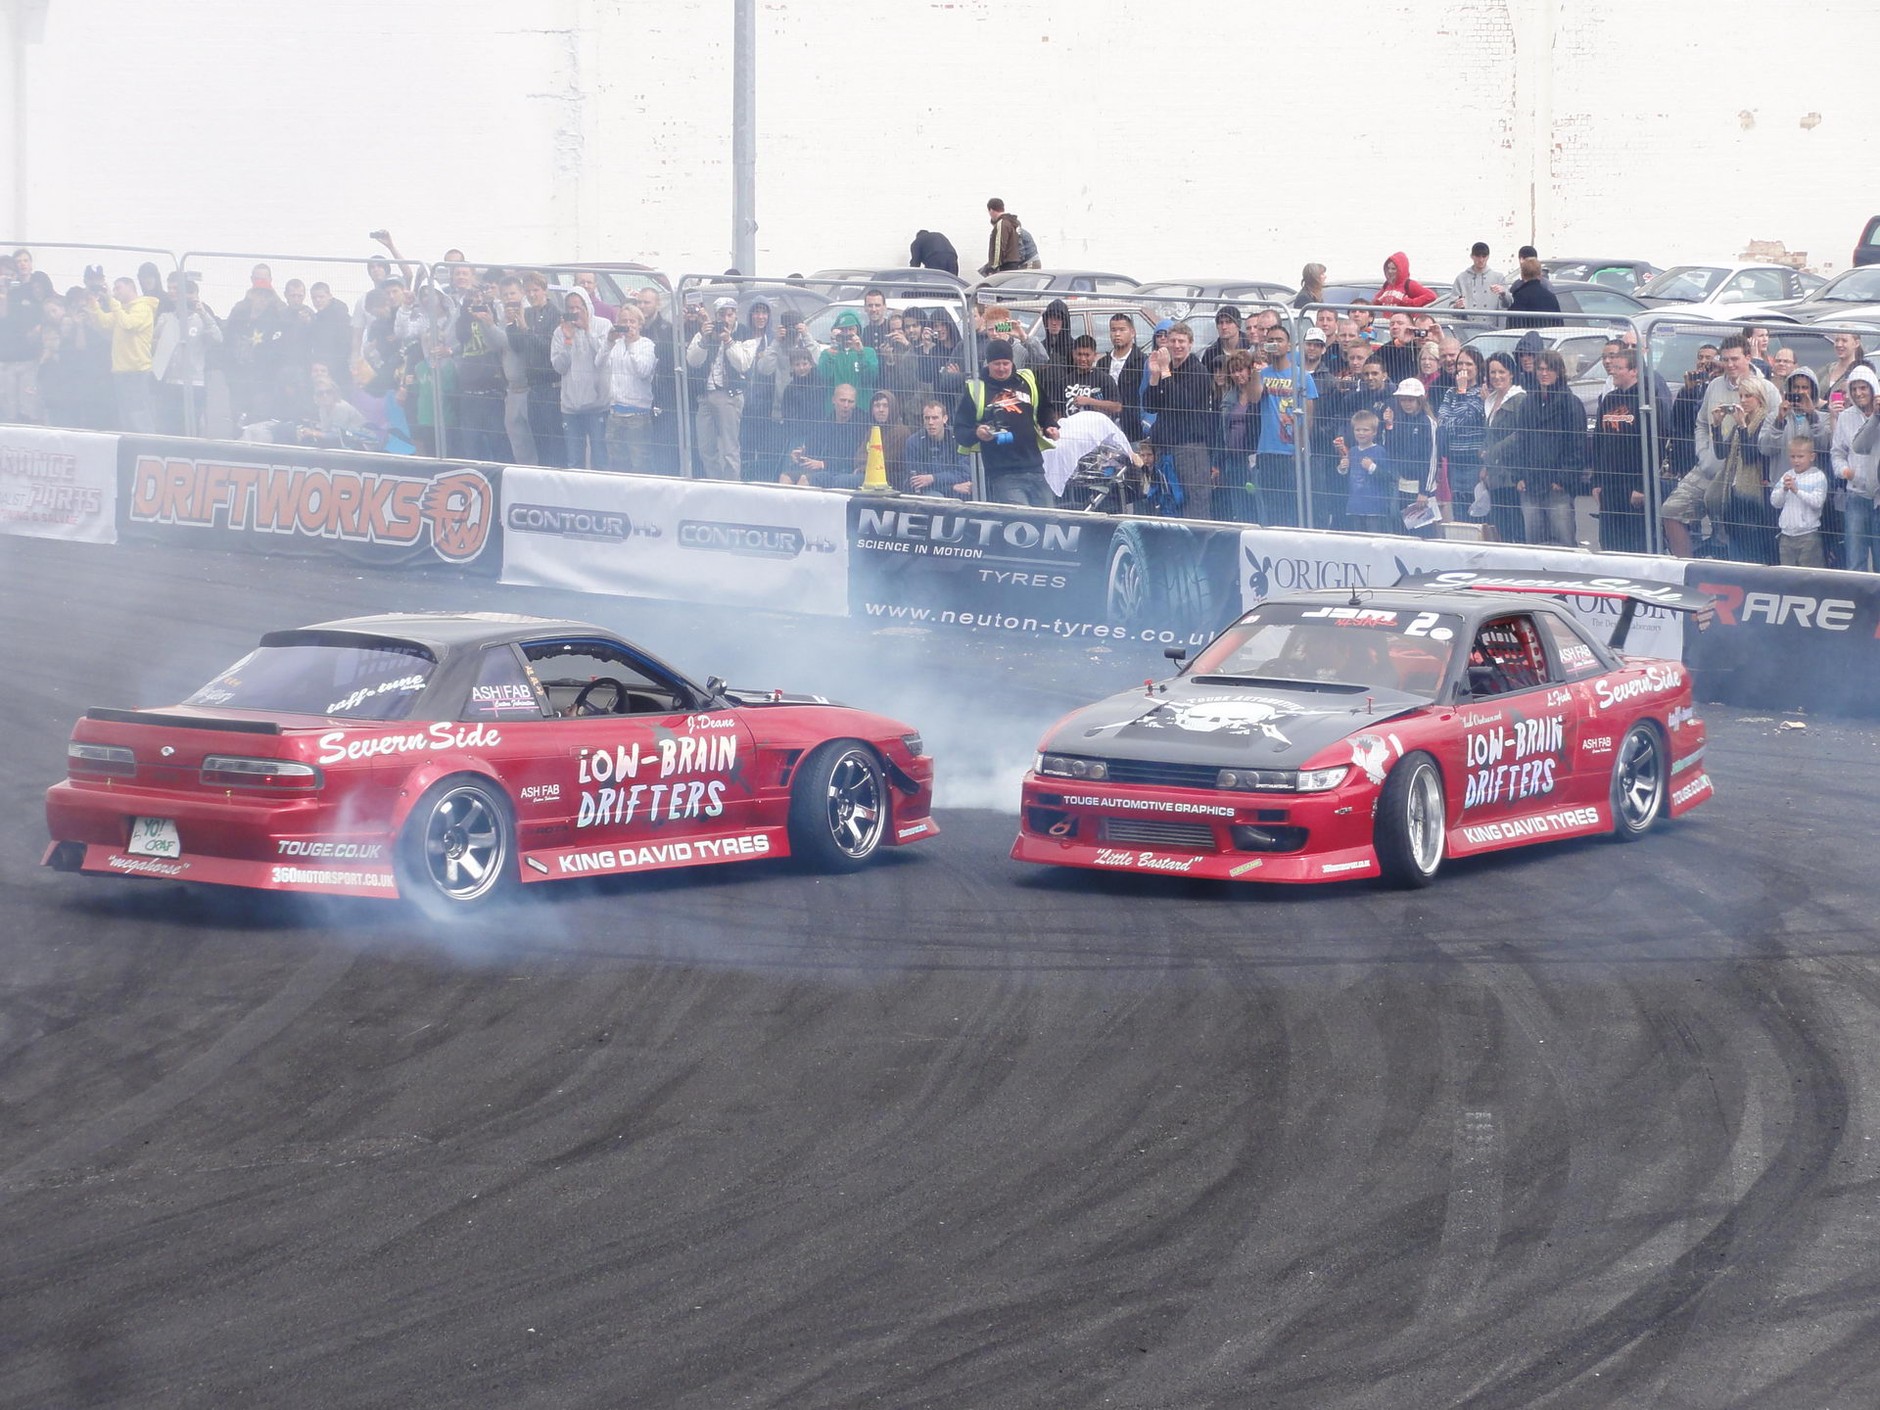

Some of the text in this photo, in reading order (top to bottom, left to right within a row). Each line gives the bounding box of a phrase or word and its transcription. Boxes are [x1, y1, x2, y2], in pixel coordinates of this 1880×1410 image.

[26, 483, 102, 515] PARTS
[130, 456, 432, 546] DRIFTWORKS
[510, 508, 624, 536] CONTOUR
[680, 524, 797, 551] CONTOUR
[856, 508, 1082, 552] NEUTON
[856, 538, 983, 560] SCIENCE IN MOTION
[978, 569, 1067, 589] TYRES
[1274, 557, 1371, 589] ORIGIN
[1587, 578, 1683, 601] Side
[1697, 582, 1857, 631] RARE
[1574, 644, 1591, 660] FAB
[472, 684, 531, 700] ASH FAB
[1595, 666, 1682, 709] Severn Side
[319, 722, 501, 765] Severn Side
[1467, 715, 1564, 767] LOW-BRAIN
[1582, 736, 1612, 750] ASH FAB
[578, 735, 737, 784] LOW-BRAIN
[521, 784, 560, 799] ASH FAB
[1464, 758, 1556, 810] DRIFTERS
[577, 780, 726, 828] DRIFTERS
[1063, 795, 1235, 817] TOUGE AUTOMOTIVE GRAPHICS
[1463, 807, 1599, 844] KING DAVID TYRES
[278, 839, 382, 859] TOUGE.CO.UK
[558, 834, 770, 874] KING DAVID TYRES
